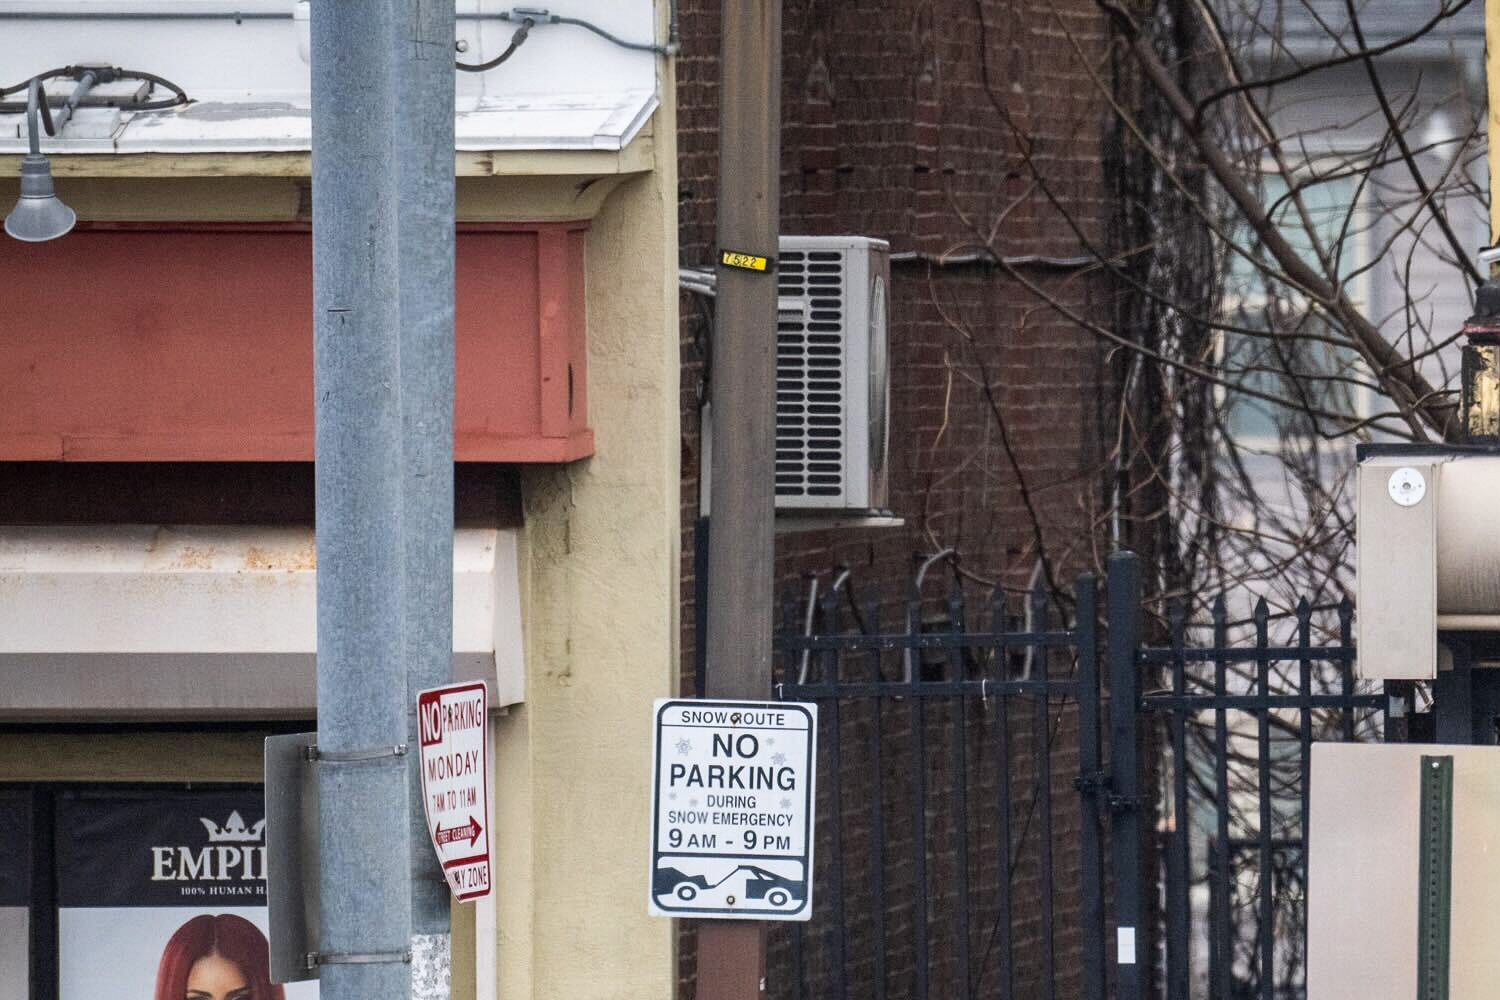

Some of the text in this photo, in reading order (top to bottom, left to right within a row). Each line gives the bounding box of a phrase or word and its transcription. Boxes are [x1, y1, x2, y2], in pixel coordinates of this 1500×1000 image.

[725, 252, 757, 267] 7522
[421, 698, 482, 743] NO PARKING
[681, 710, 785, 726] SNOW ROUTE
[712, 733, 760, 759] NO
[428, 749, 479, 781] MONDAY
[669, 763, 796, 791] PARKING
[447, 790, 457, 812] TO
[706, 794, 757, 809] DURING
[668, 810, 794, 827] SNOW EMERGENCY
[668, 828, 683, 848] 9
[687, 833, 717, 849] AM
[743, 829, 758, 850] 9
[763, 835, 791, 850] PM
[468, 865, 488, 887] ZONE
[181, 886, 268, 895] 100% HUMAN H
